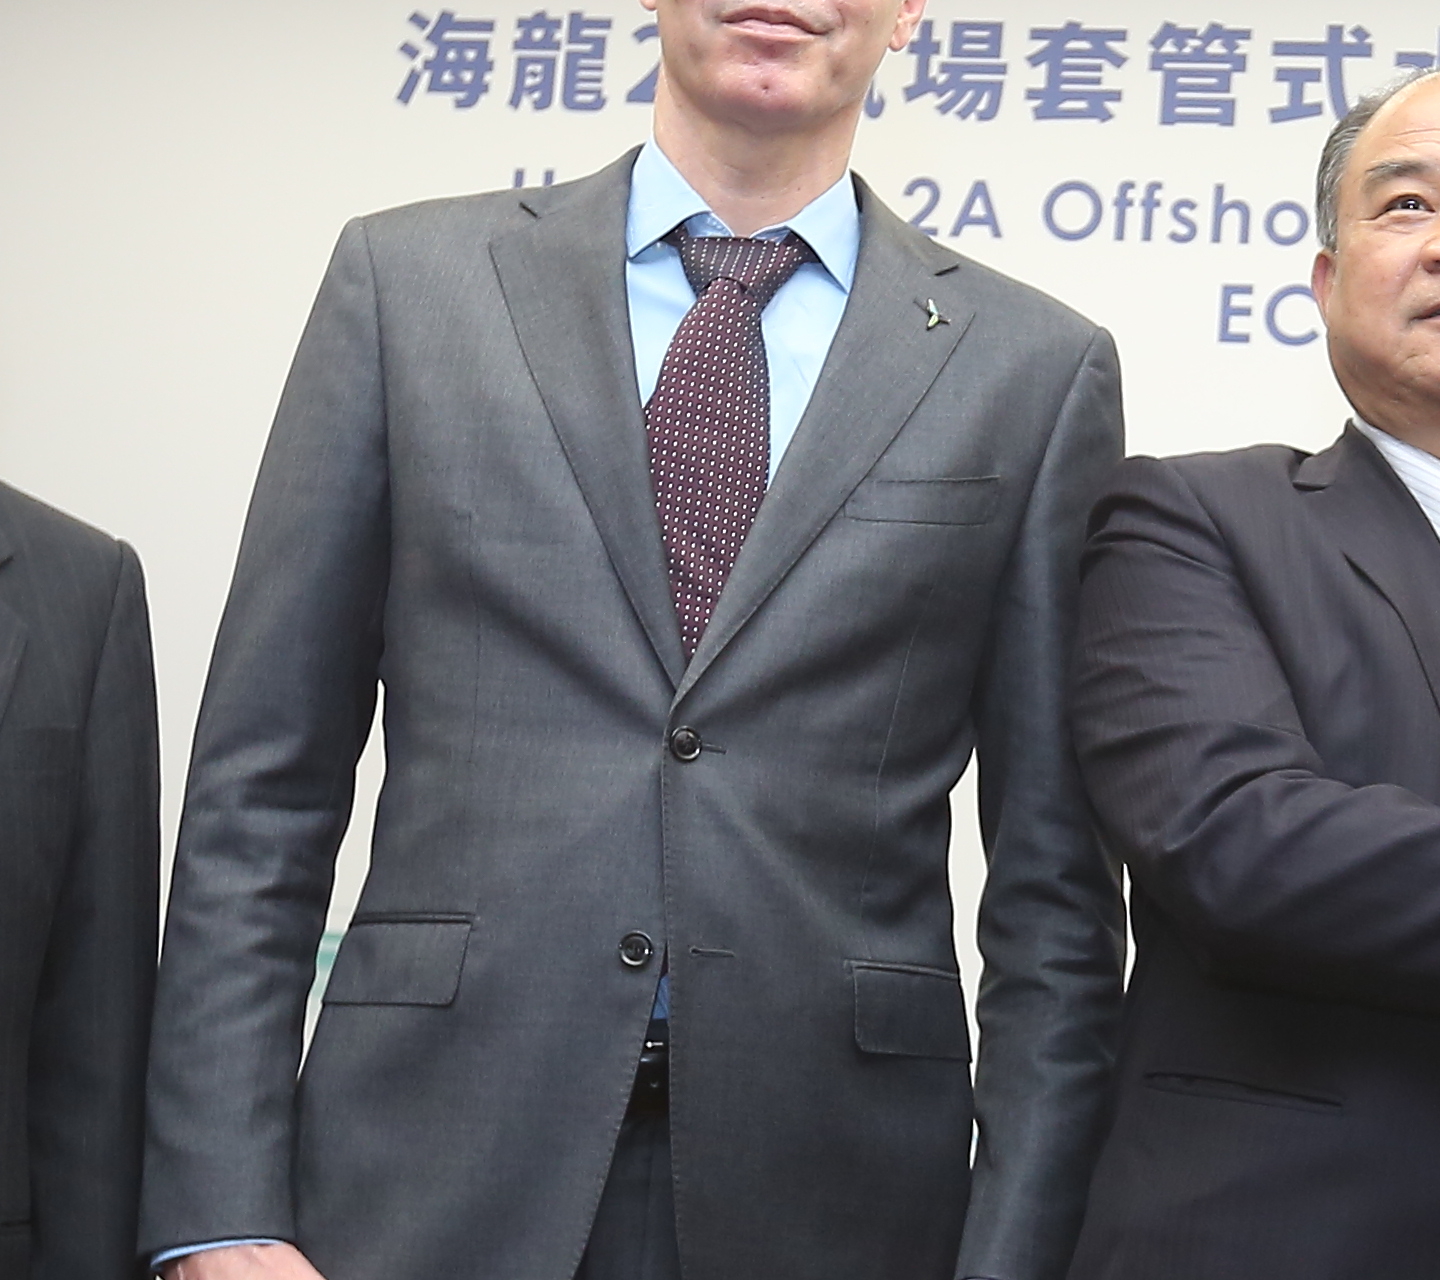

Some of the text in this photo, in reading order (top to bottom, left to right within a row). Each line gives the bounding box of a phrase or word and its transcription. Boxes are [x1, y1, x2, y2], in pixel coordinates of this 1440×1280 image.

[902, 177, 1003, 239] 2A
[1043, 179, 1309, 245] Offsho
[1217, 284, 1317, 347] EC
